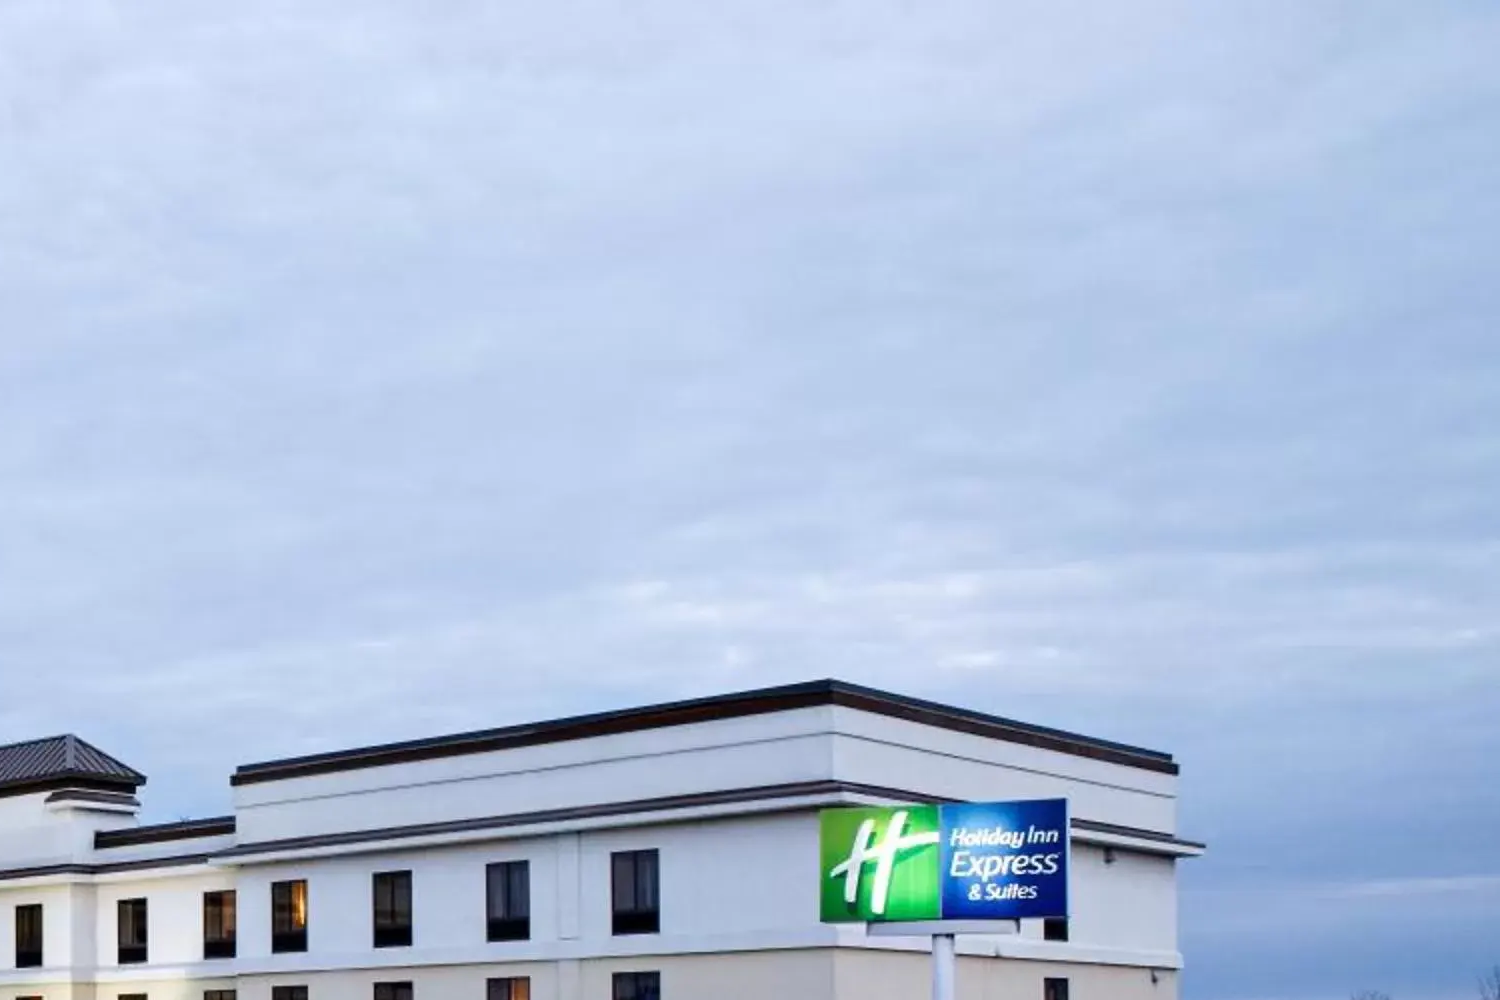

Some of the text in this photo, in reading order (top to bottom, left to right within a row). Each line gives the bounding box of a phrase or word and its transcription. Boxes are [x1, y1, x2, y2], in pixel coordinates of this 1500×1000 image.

[949, 824, 1059, 849] Holiday Inn
[950, 851, 1060, 883] Express
[967, 883, 1038, 901] & Suites
